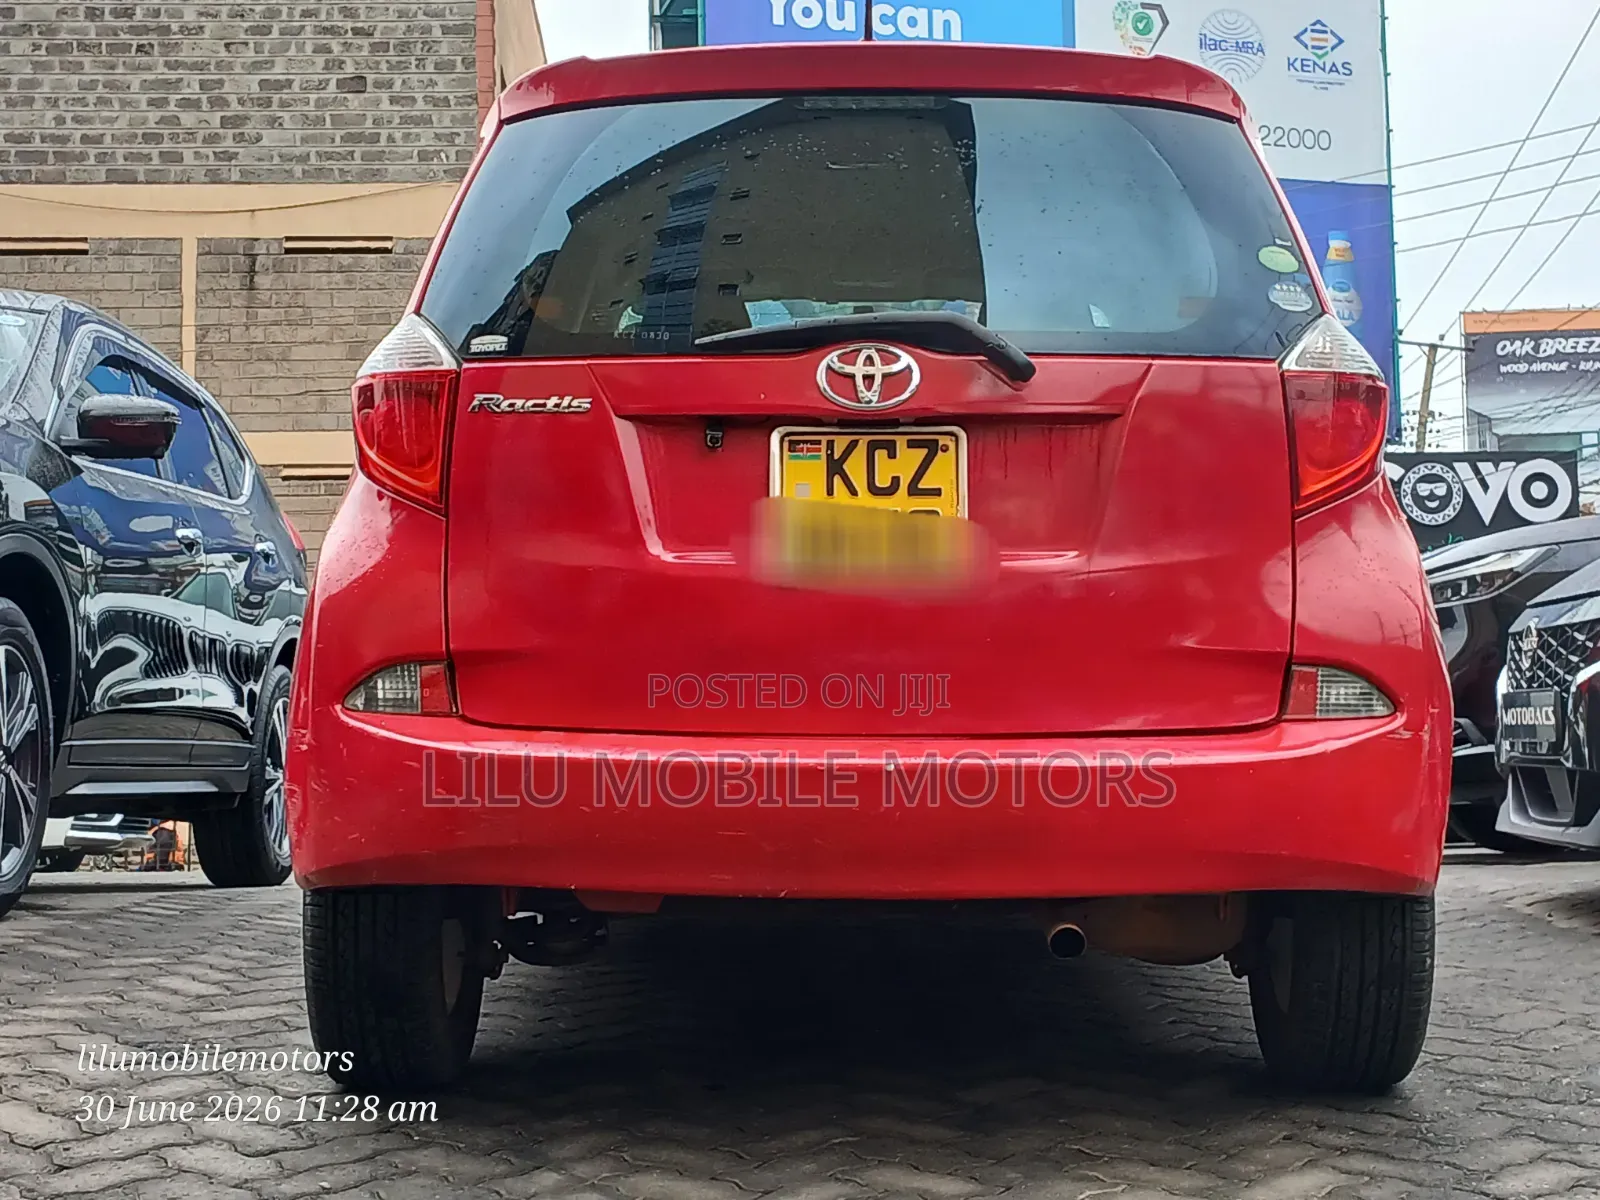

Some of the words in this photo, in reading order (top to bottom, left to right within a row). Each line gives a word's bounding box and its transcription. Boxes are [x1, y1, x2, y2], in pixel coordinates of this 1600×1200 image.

[767, 0, 857, 32] You
[872, 4, 962, 41] can
[1287, 56, 1353, 77] KENAS
[1258, 124, 1332, 151] 22000
[1496, 337, 1538, 358] OAK
[467, 393, 593, 413] Ractis
[826, 439, 943, 497] KCZ
[1383, 457, 1573, 527] OVO
